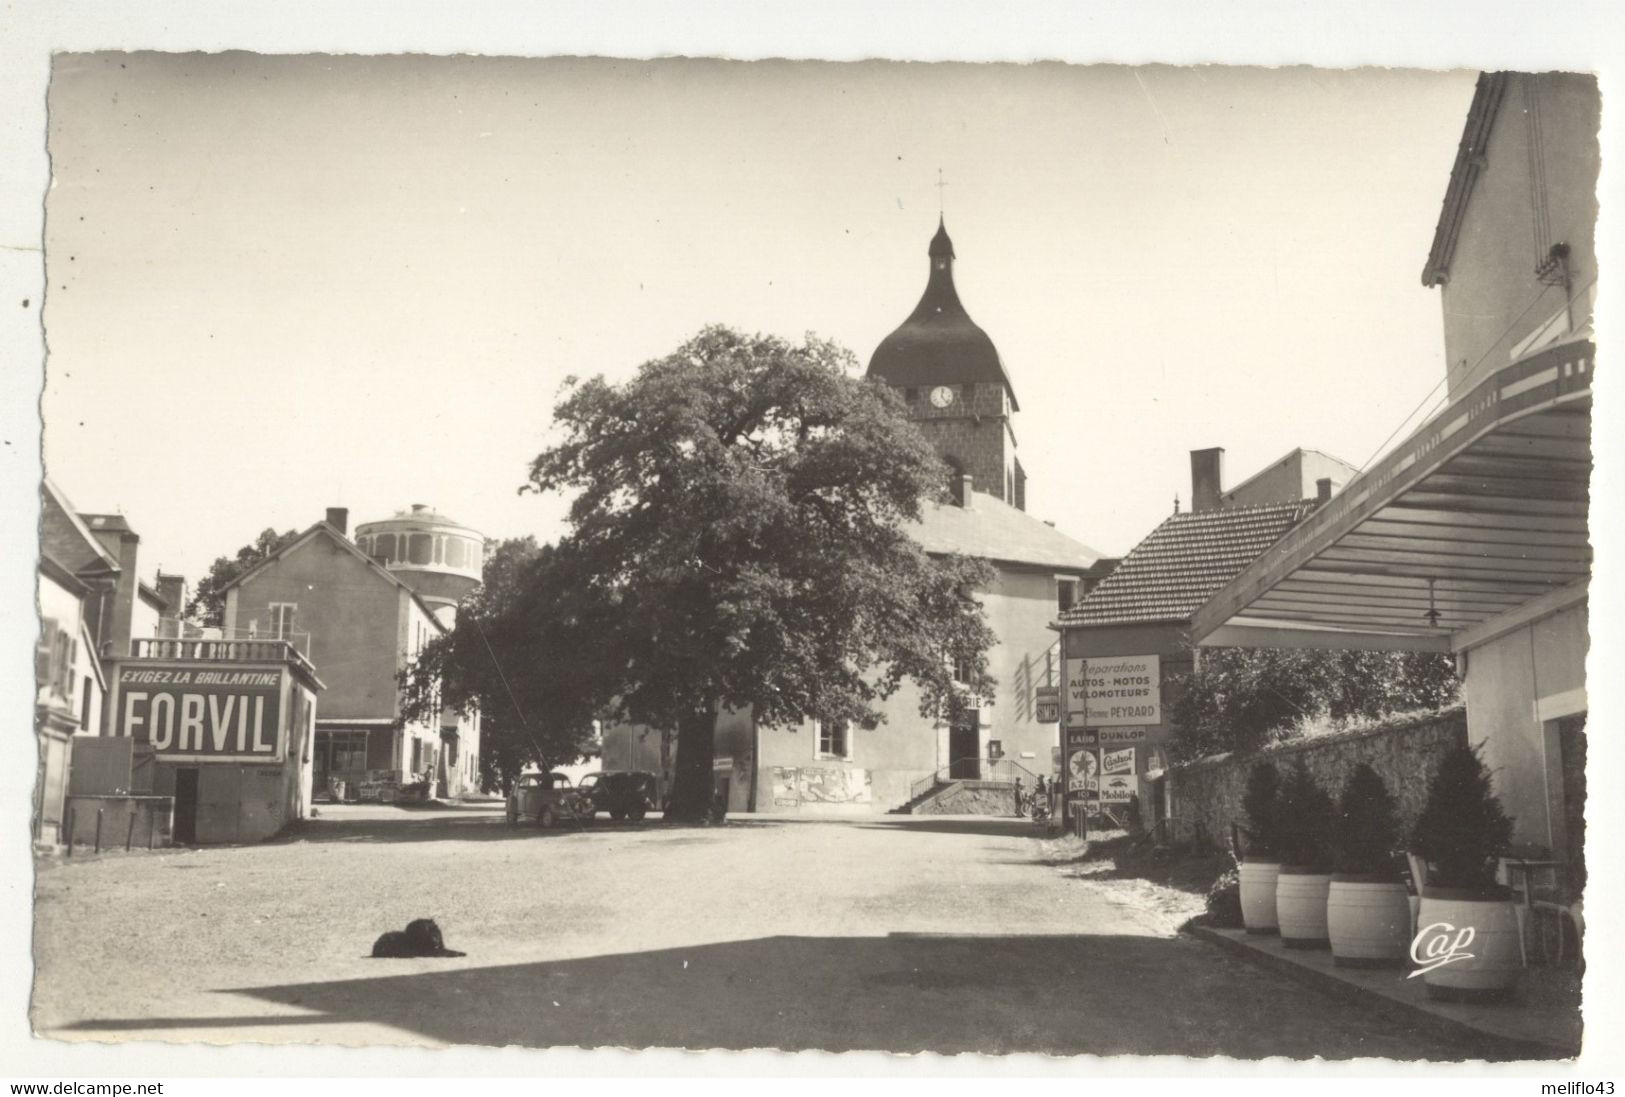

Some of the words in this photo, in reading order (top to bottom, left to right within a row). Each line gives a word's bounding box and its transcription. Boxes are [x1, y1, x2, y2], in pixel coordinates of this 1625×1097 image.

[120, 670, 172, 683] EXIGEZ
[172, 671, 191, 684] LA
[194, 671, 280, 685] BRILLANTINE
[1070, 678, 1105, 687] AUTOS
[1113, 676, 1150, 686] MOTOS
[1110, 705, 1155, 718] PEYRARD
[124, 692, 272, 752] FORVIL
[1101, 731, 1145, 740] DUNLOP
